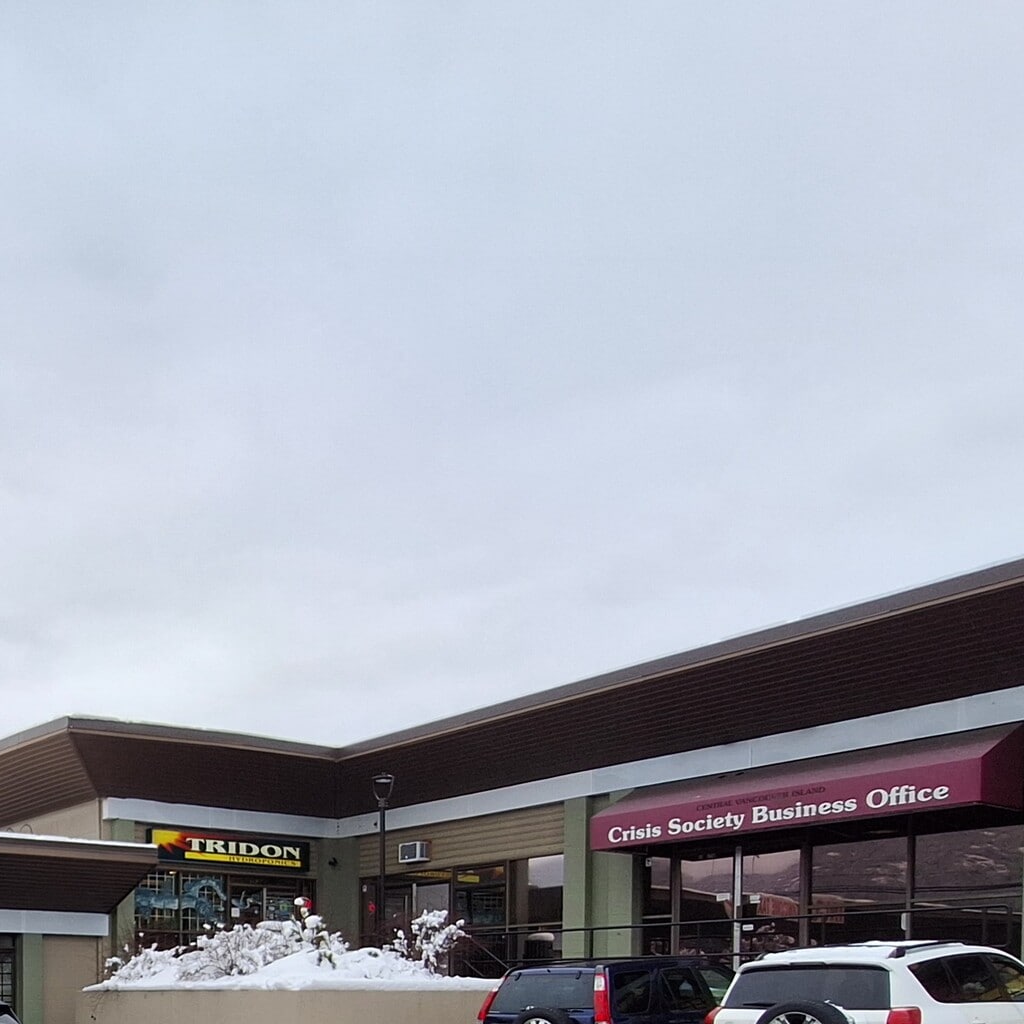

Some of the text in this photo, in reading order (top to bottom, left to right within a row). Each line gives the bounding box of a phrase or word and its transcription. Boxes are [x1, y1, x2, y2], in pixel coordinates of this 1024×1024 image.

[608, 784, 950, 843] Crisis Society Business Office
[186, 837, 301, 859] TRIDON
